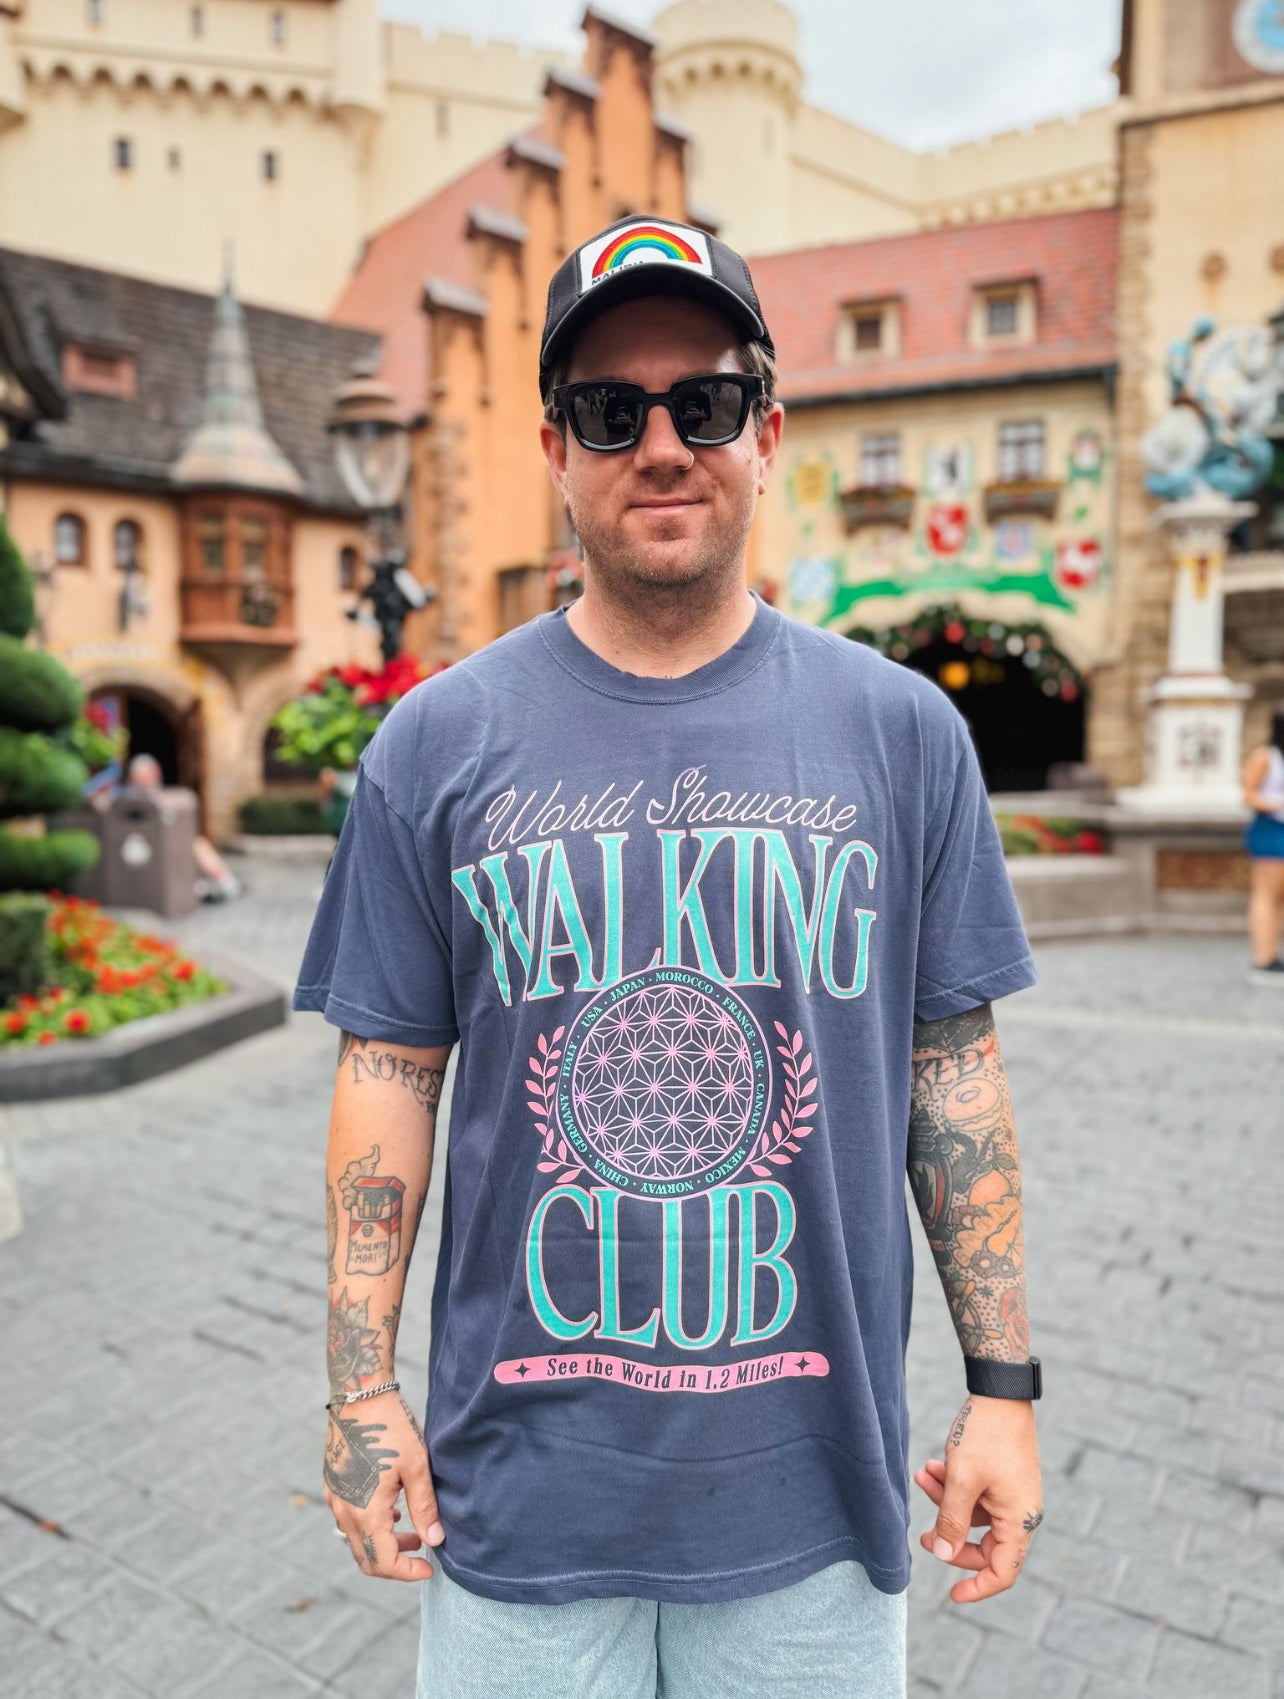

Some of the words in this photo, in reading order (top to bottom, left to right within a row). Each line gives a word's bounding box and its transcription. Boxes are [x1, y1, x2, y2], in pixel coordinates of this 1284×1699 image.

[486, 779, 644, 851] World
[646, 764, 858, 832] Showcase
[451, 826, 879, 1008] WALKING
[609, 977, 646, 1001] JAPAN
[655, 971, 714, 995] MOROCCO
[581, 1005, 603, 1028] USA
[722, 997, 756, 1040] FRANCE
[563, 1040, 578, 1078] ITALY
[753, 1050, 765, 1070] UK
[911, 1049, 984, 1102] KED
[560, 1093, 588, 1154] GERMANY
[747, 1083, 765, 1136] CANADA
[594, 1159, 629, 1187] CHINA
[705, 1146, 747, 1184] MEXICO
[640, 1180, 694, 1195] NORWAY
[350, 1239, 388, 1253] MEMENTO
[526, 1180, 798, 1351] CLUB
[547, 1357, 578, 1377] See
[586, 1357, 613, 1377] the
[622, 1361, 672, 1389] World
[679, 1370, 697, 1388] in
[705, 1368, 730, 1390] 1.2
[735, 1356, 784, 1385] Miles!
